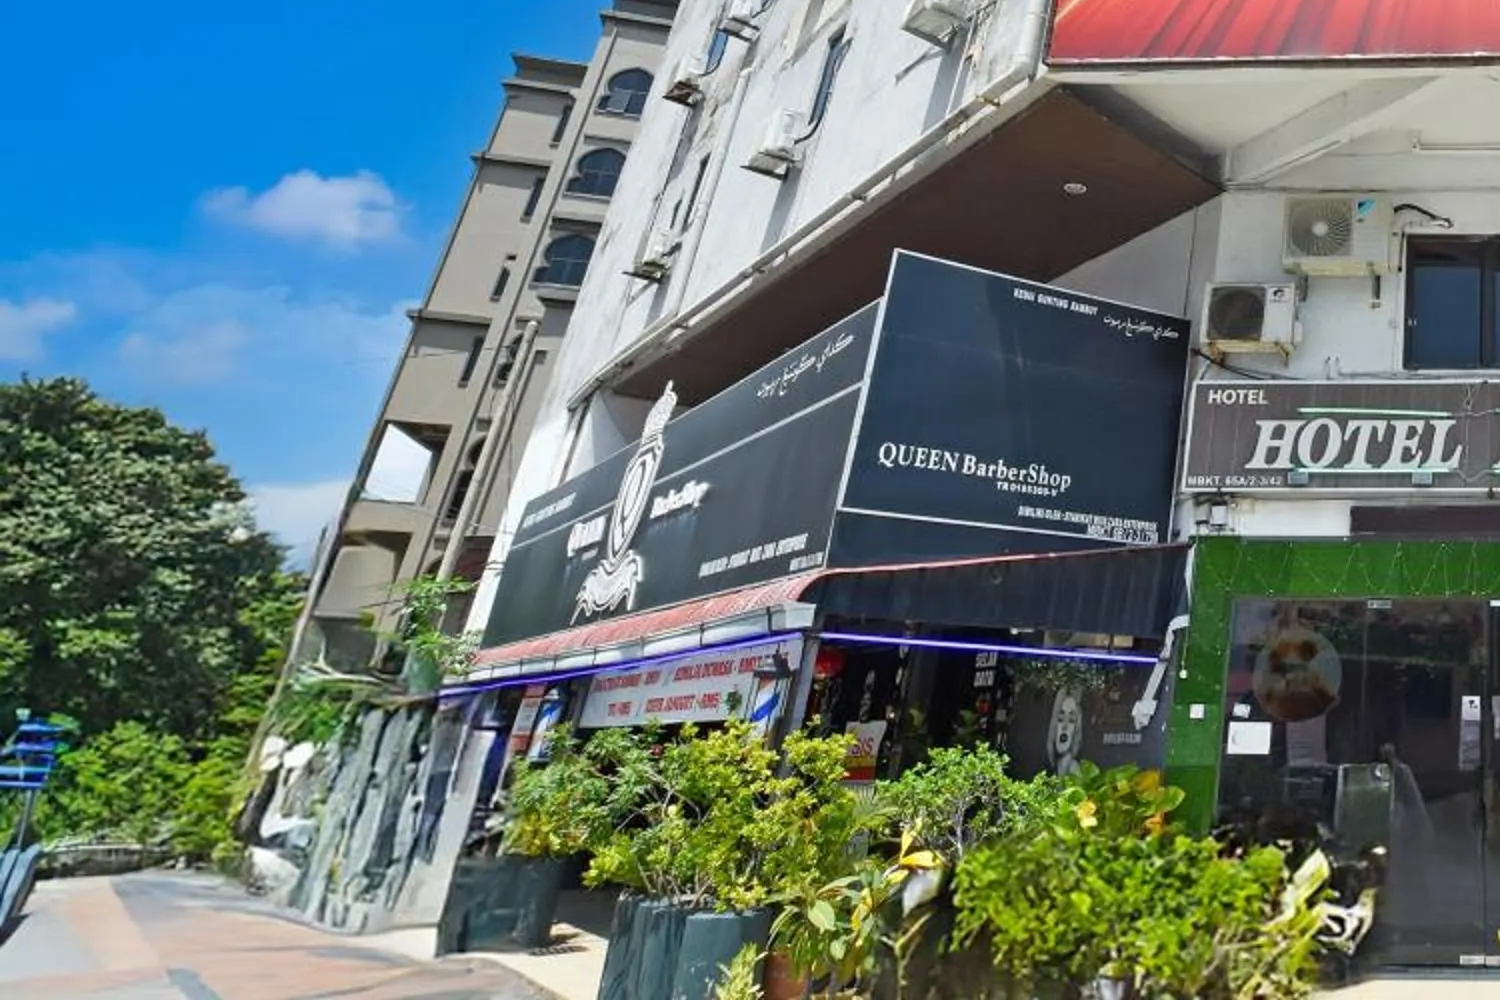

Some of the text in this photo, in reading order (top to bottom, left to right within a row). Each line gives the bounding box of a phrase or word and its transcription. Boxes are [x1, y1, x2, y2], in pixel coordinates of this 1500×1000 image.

[1208, 389, 1268, 405] HOTEL
[879, 442, 1072, 492] QUEEN BarberShop
[1244, 418, 1465, 470] HOTEL
